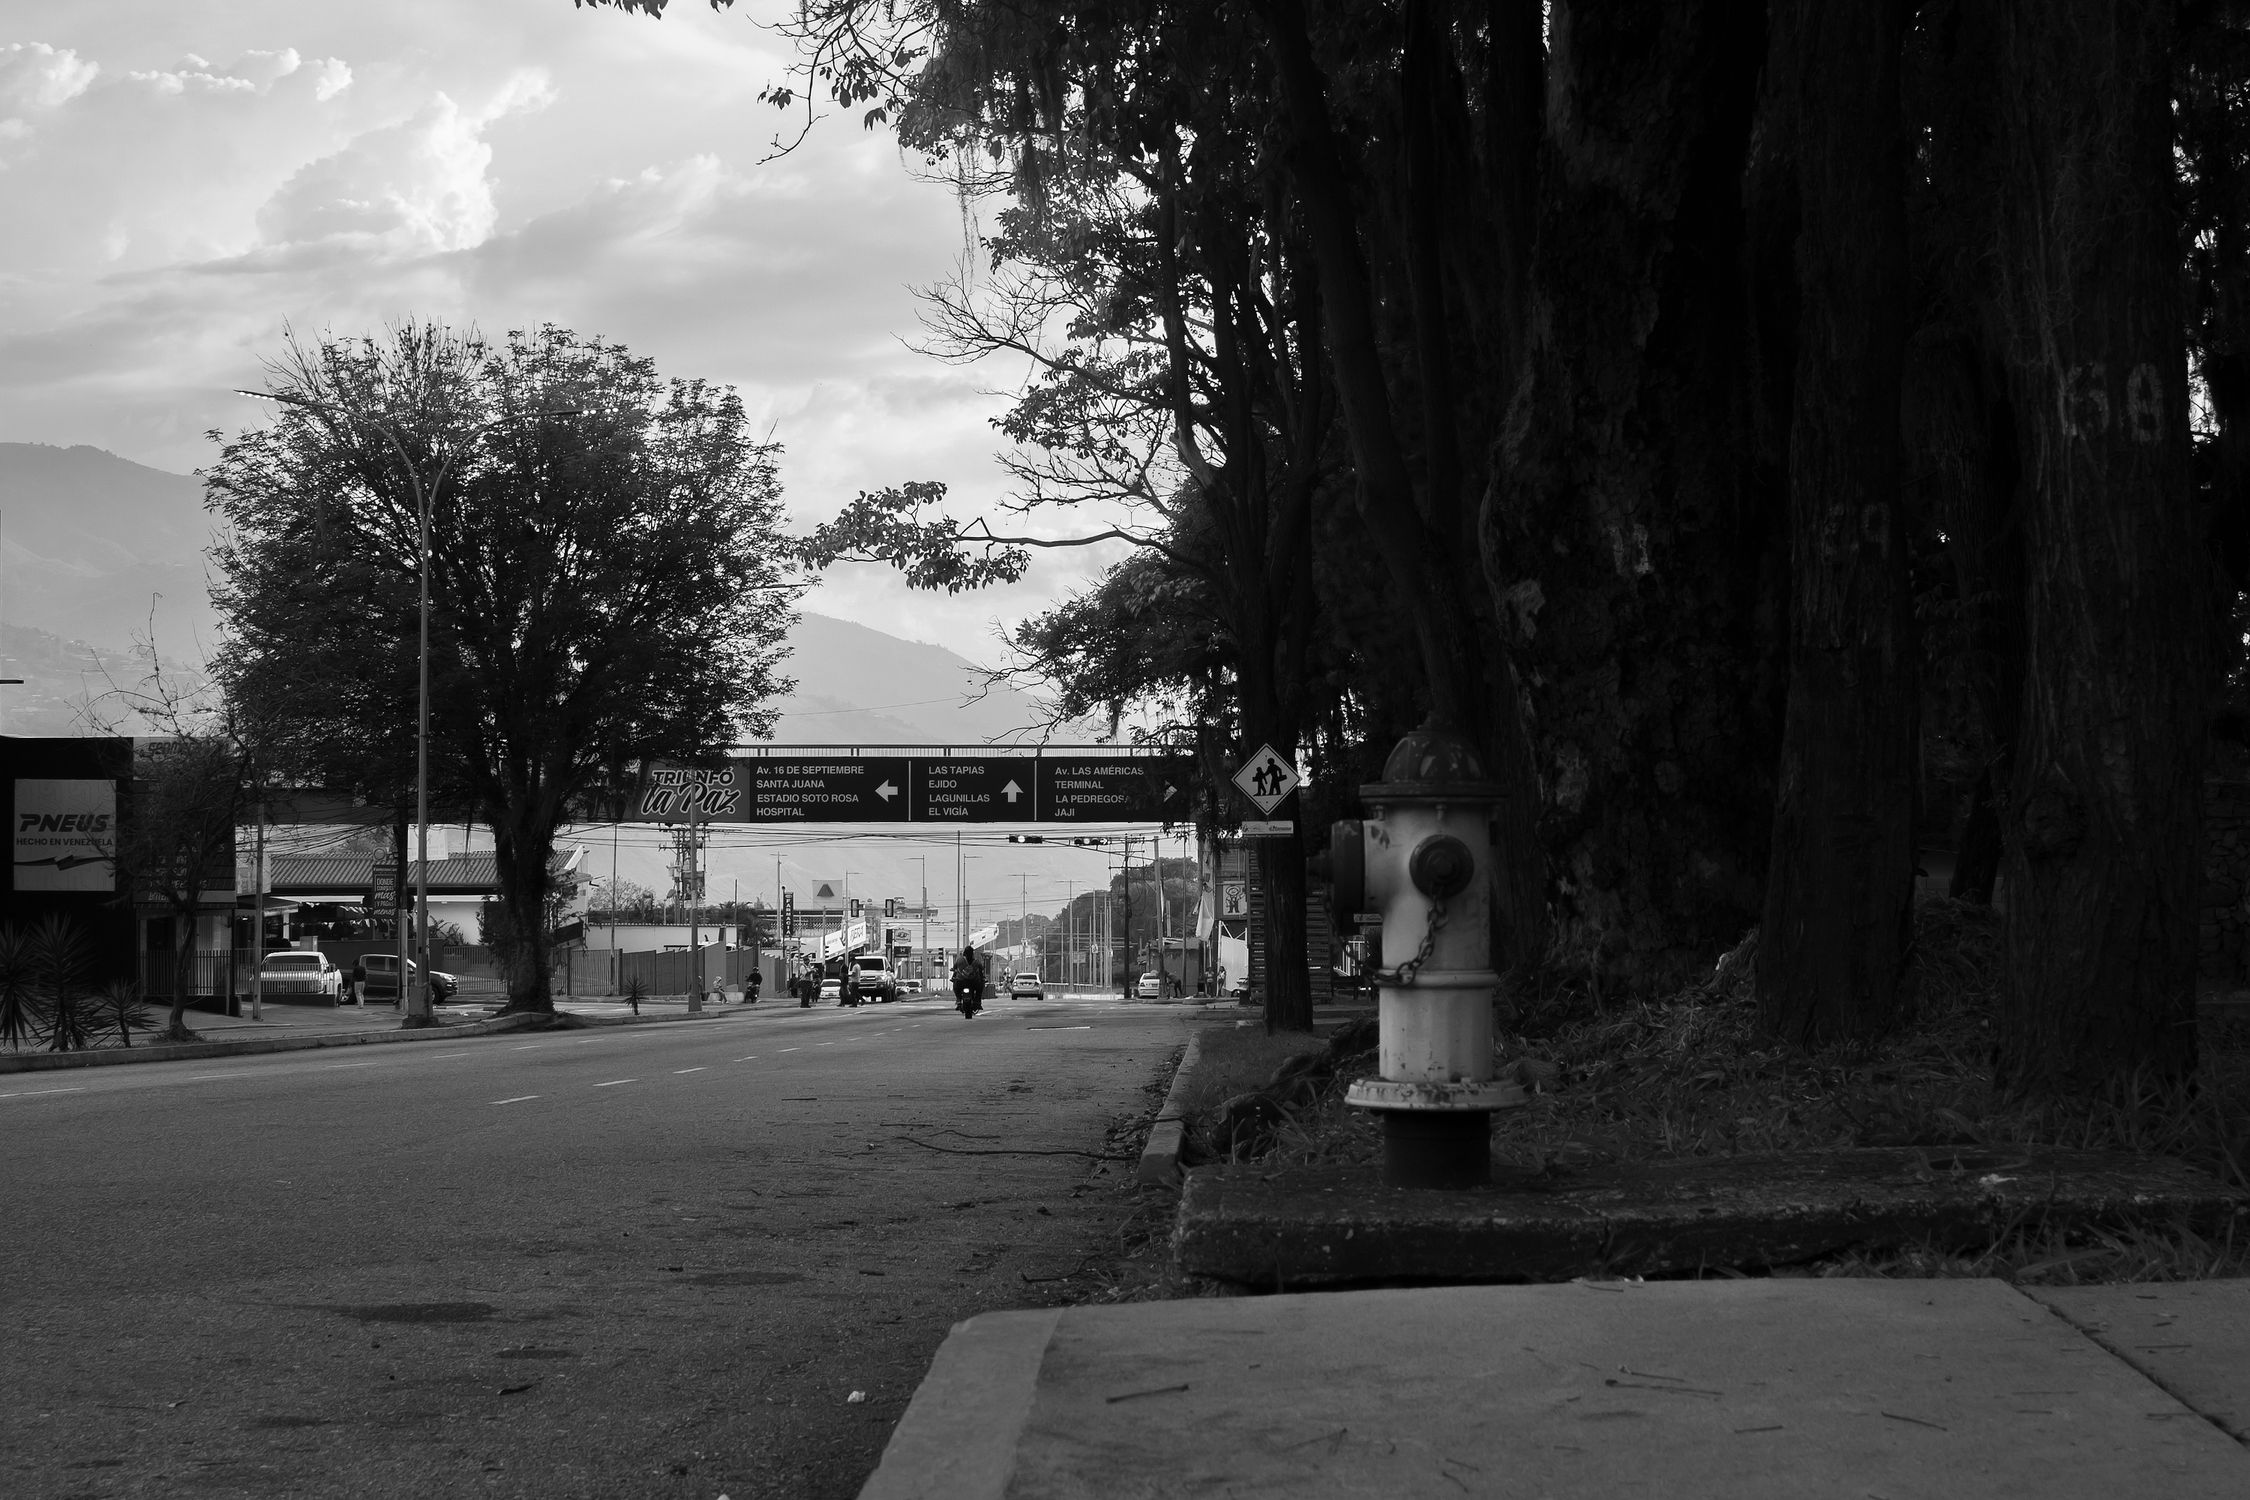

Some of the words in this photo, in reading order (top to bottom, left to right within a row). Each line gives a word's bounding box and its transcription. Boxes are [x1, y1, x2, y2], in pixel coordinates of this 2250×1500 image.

[755, 765, 772, 775] Av.
[773, 765, 785, 775] 16
[786, 765, 801, 775] DE
[801, 765, 865, 775] SEPTIEMBRE
[928, 765, 948, 775] LAS
[949, 765, 985, 775] TAPIAS
[1054, 766, 1070, 776] Av.
[1071, 766, 1092, 776] LAS
[1093, 764, 1145, 776] AMÉRICAS
[756, 779, 790, 789] SANTA
[791, 779, 825, 789] JUANA
[928, 779, 958, 789] EJIDO
[1054, 780, 1105, 789] TERMINAL
[677, 781, 742, 815] Paz
[757, 793, 800, 803] ESTADIO
[801, 793, 830, 803] SOTO
[831, 793, 860, 803] ROSA
[929, 793, 991, 803] LAGUNILLAS
[1055, 794, 1069, 804] LA
[756, 807, 805, 817] HOSPITAL
[928, 807, 942, 816] EL
[942, 805, 969, 816] VIGÍA
[1054, 807, 1075, 817] JAJI
[19, 813, 111, 832] PNEUS
[16, 838, 48, 846] HECHO
[49, 838, 61, 846] EN
[63, 838, 113, 846] VENEZUELA
